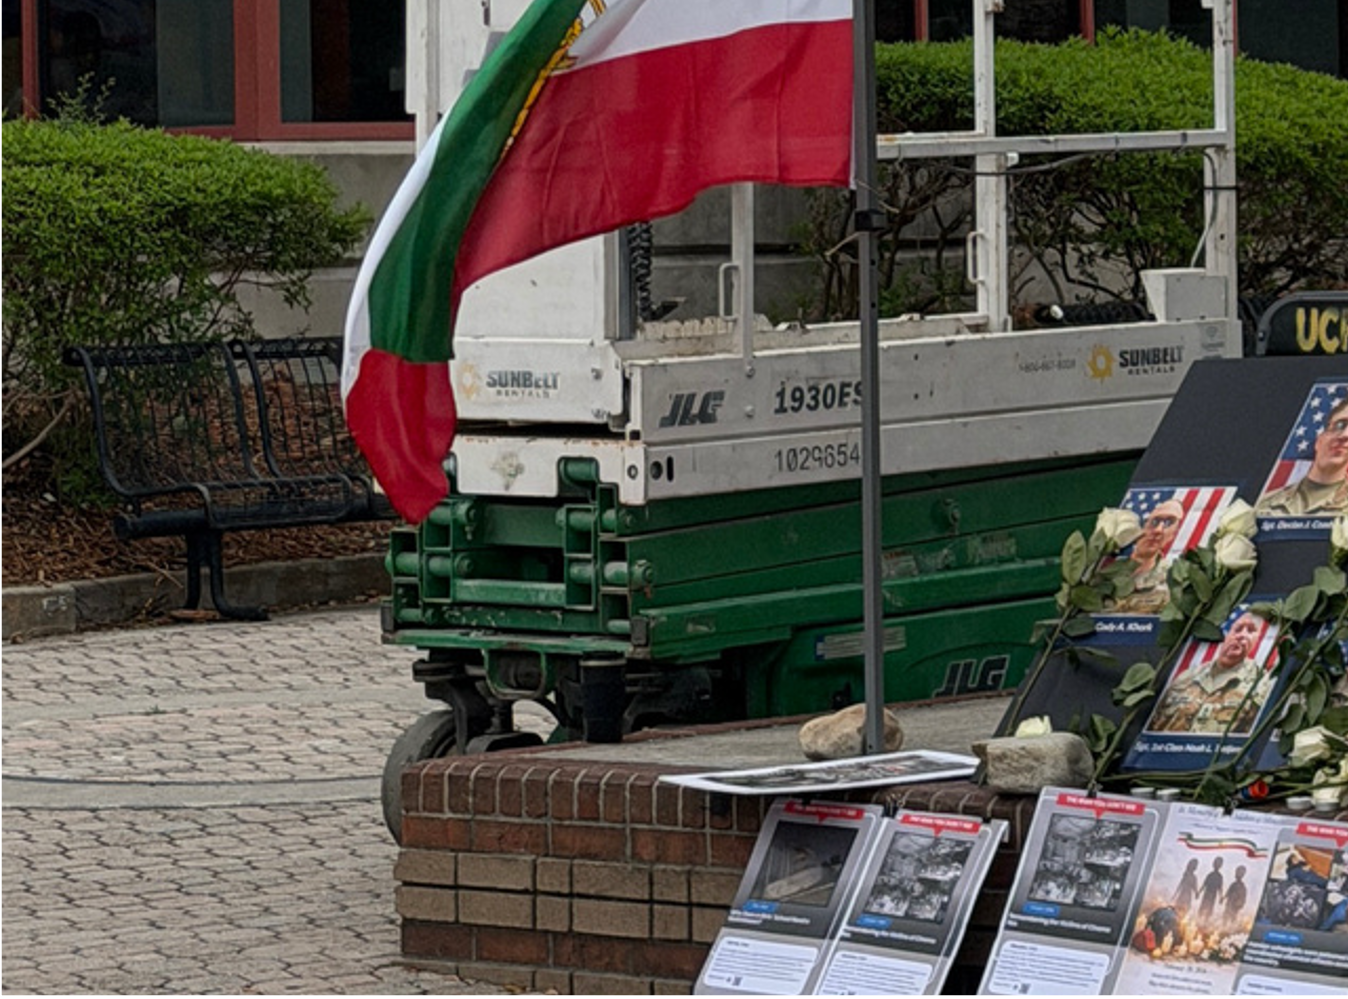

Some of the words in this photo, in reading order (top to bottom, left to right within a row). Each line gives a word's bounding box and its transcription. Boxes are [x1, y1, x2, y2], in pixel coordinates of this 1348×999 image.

[1118, 347, 1184, 368] SUNBELT
[485, 370, 560, 390] SUNBELT
[1128, 366, 1176, 376] RENTALS
[658, 390, 725, 429] JLG
[931, 654, 1011, 699] JLG
